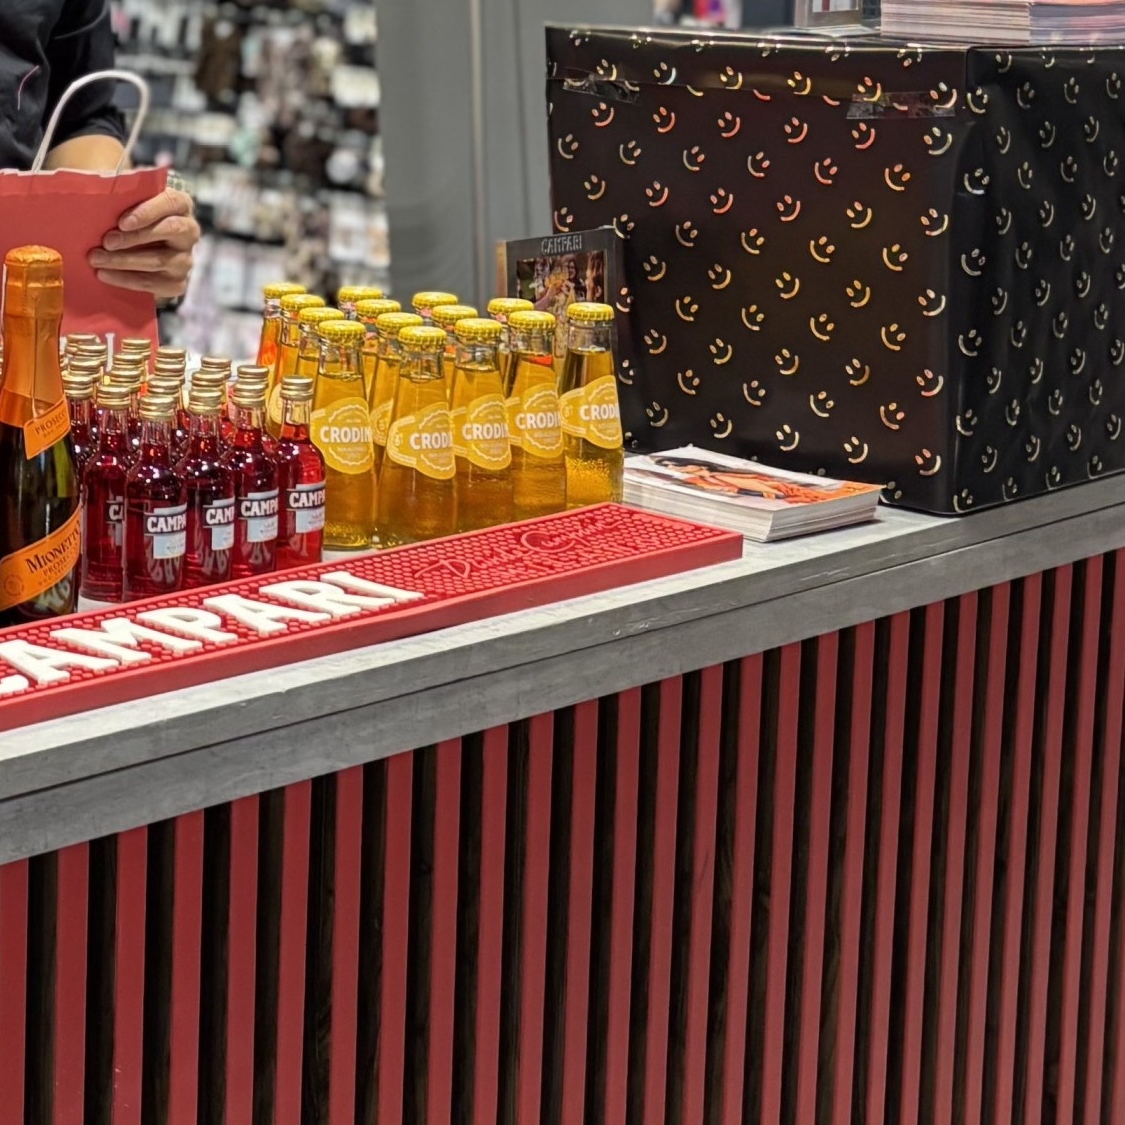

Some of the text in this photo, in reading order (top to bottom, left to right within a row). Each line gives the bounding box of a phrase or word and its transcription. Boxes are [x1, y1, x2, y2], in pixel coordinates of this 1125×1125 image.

[541, 235, 583, 254] CAMPARI
[320, 426, 373, 443] CRODIN
[147, 513, 187, 533] CAMPA
